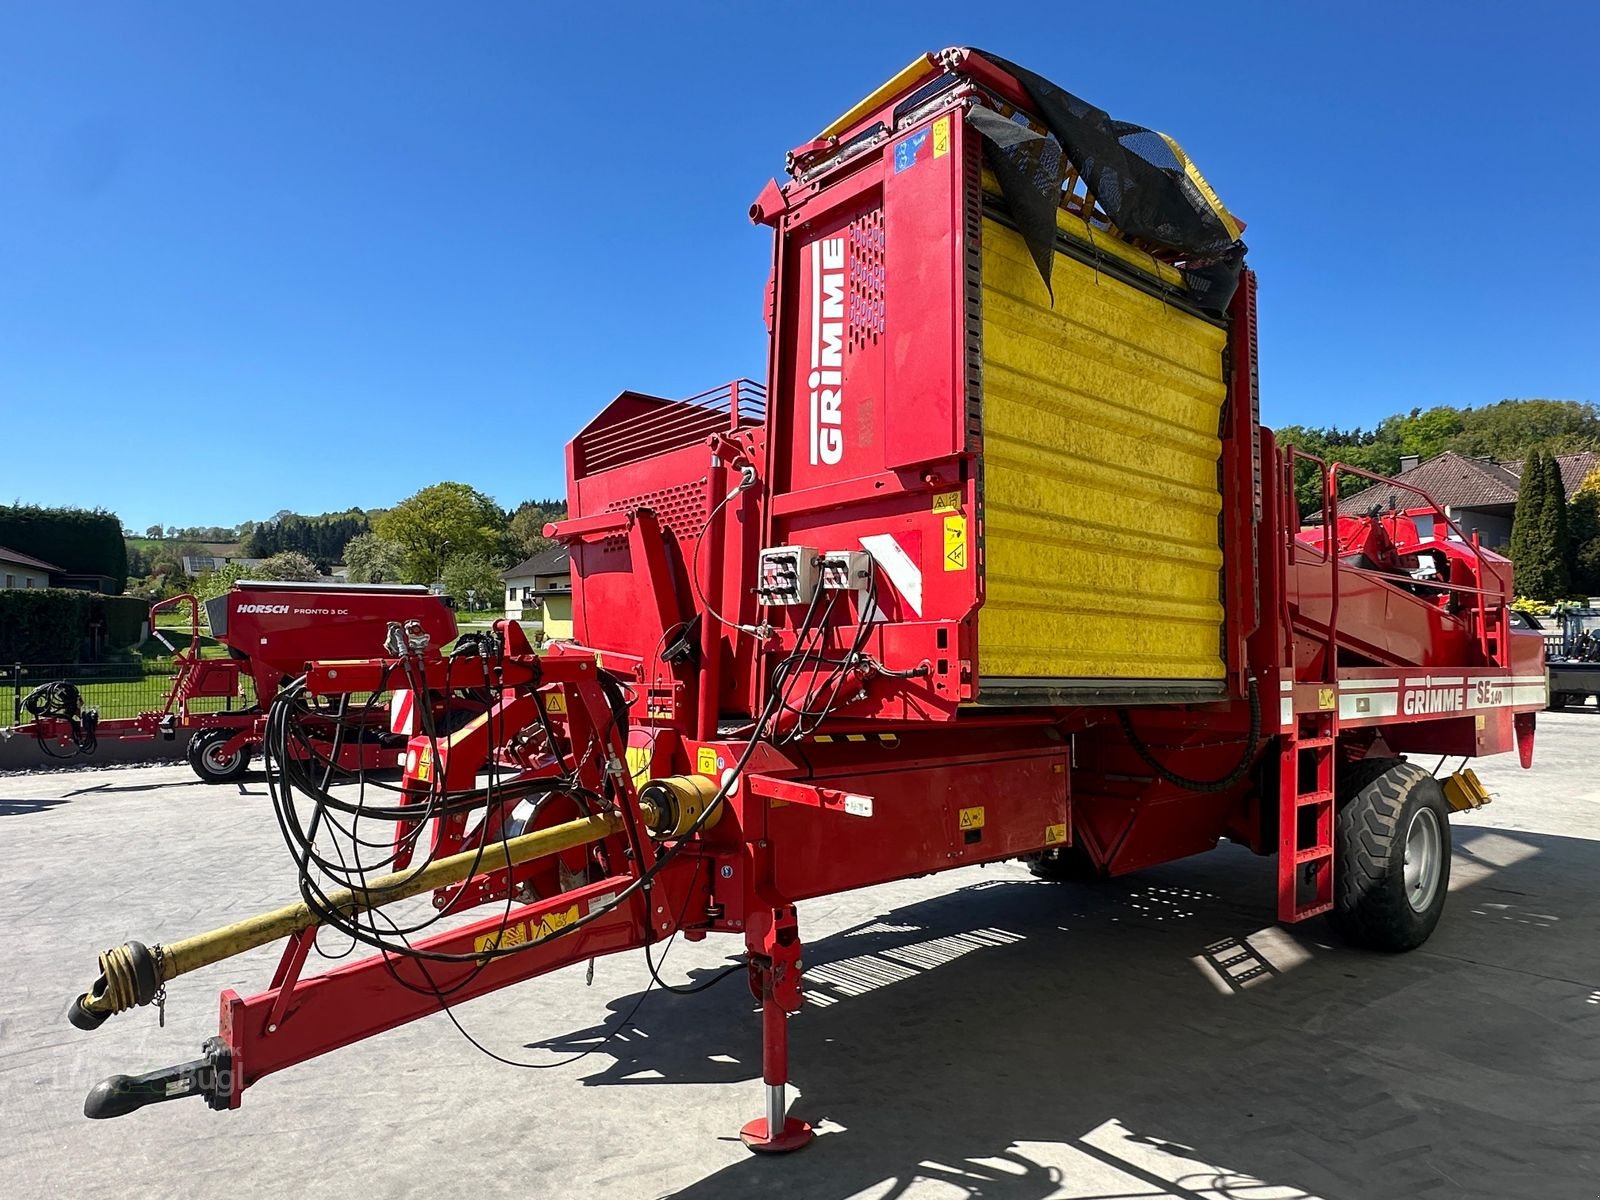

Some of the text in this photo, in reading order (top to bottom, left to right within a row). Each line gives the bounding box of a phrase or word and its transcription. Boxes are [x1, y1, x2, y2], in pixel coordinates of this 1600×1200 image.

[808, 238, 844, 466] GRIMME
[237, 604, 290, 614] HORSCH
[1404, 676, 1464, 715] GRIMME
[1477, 680, 1491, 704] SE
